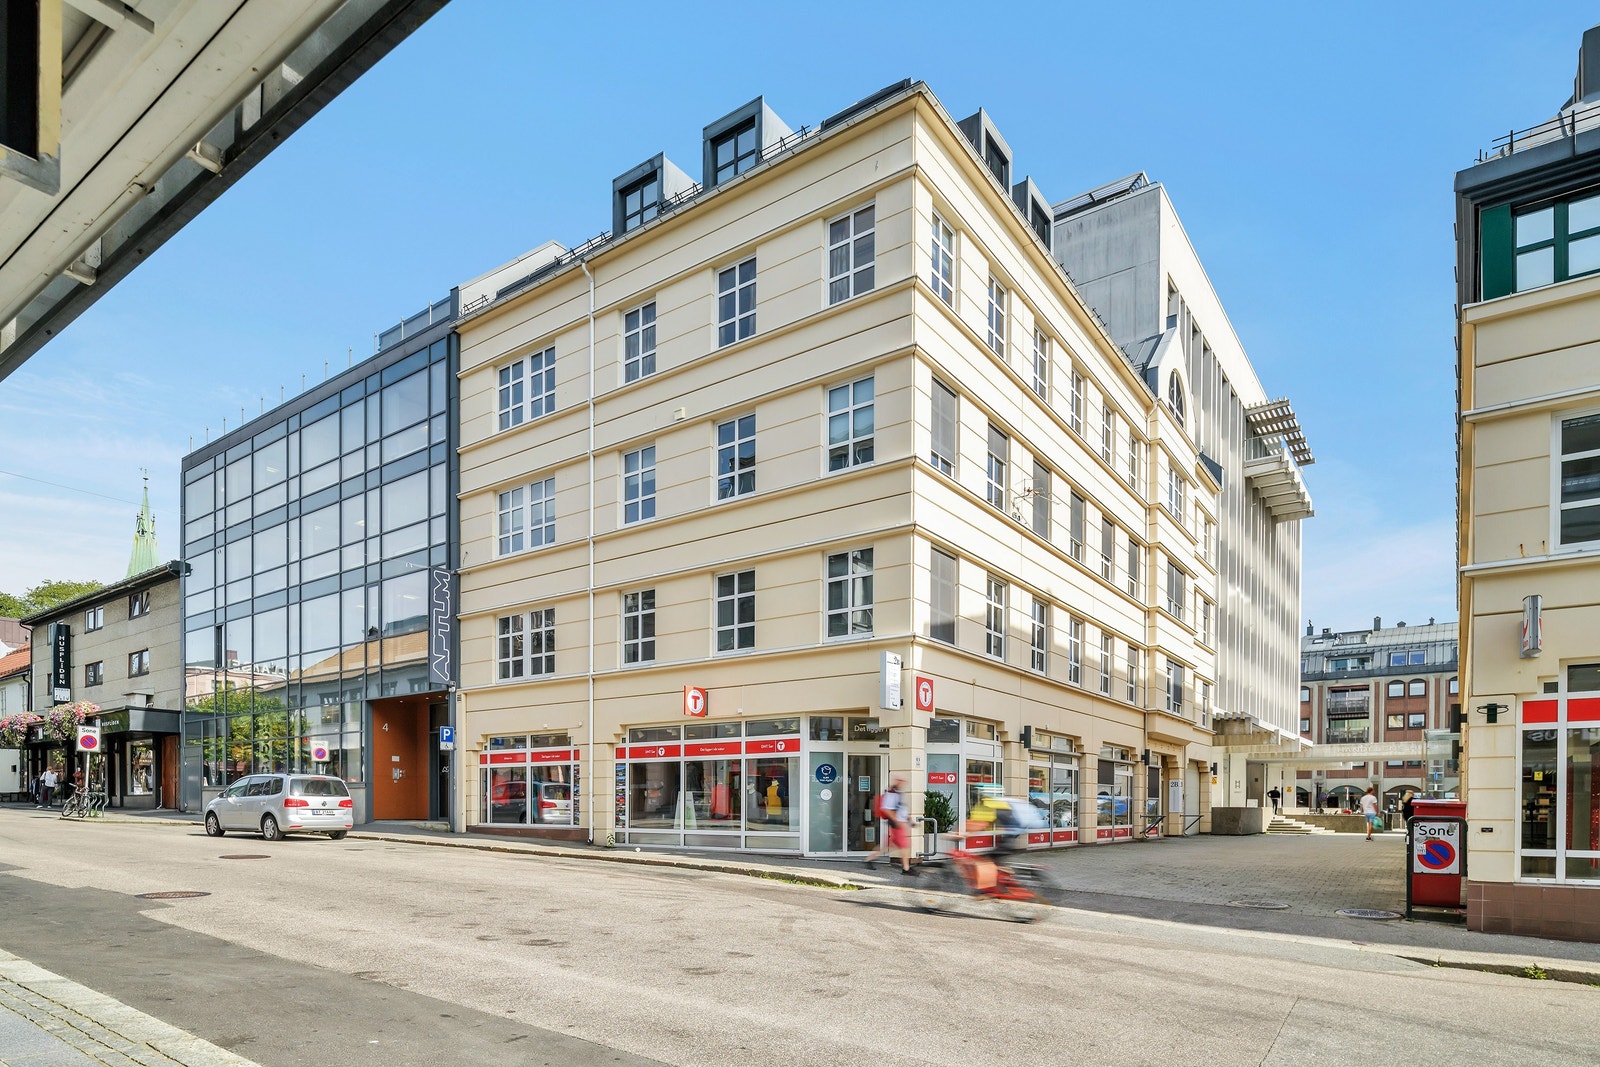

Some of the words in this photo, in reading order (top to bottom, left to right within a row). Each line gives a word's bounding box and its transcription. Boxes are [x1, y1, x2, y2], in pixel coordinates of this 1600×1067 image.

[433, 570, 450, 681] APTUM
[382, 723, 389, 732] 4
[443, 729, 451, 740] P
